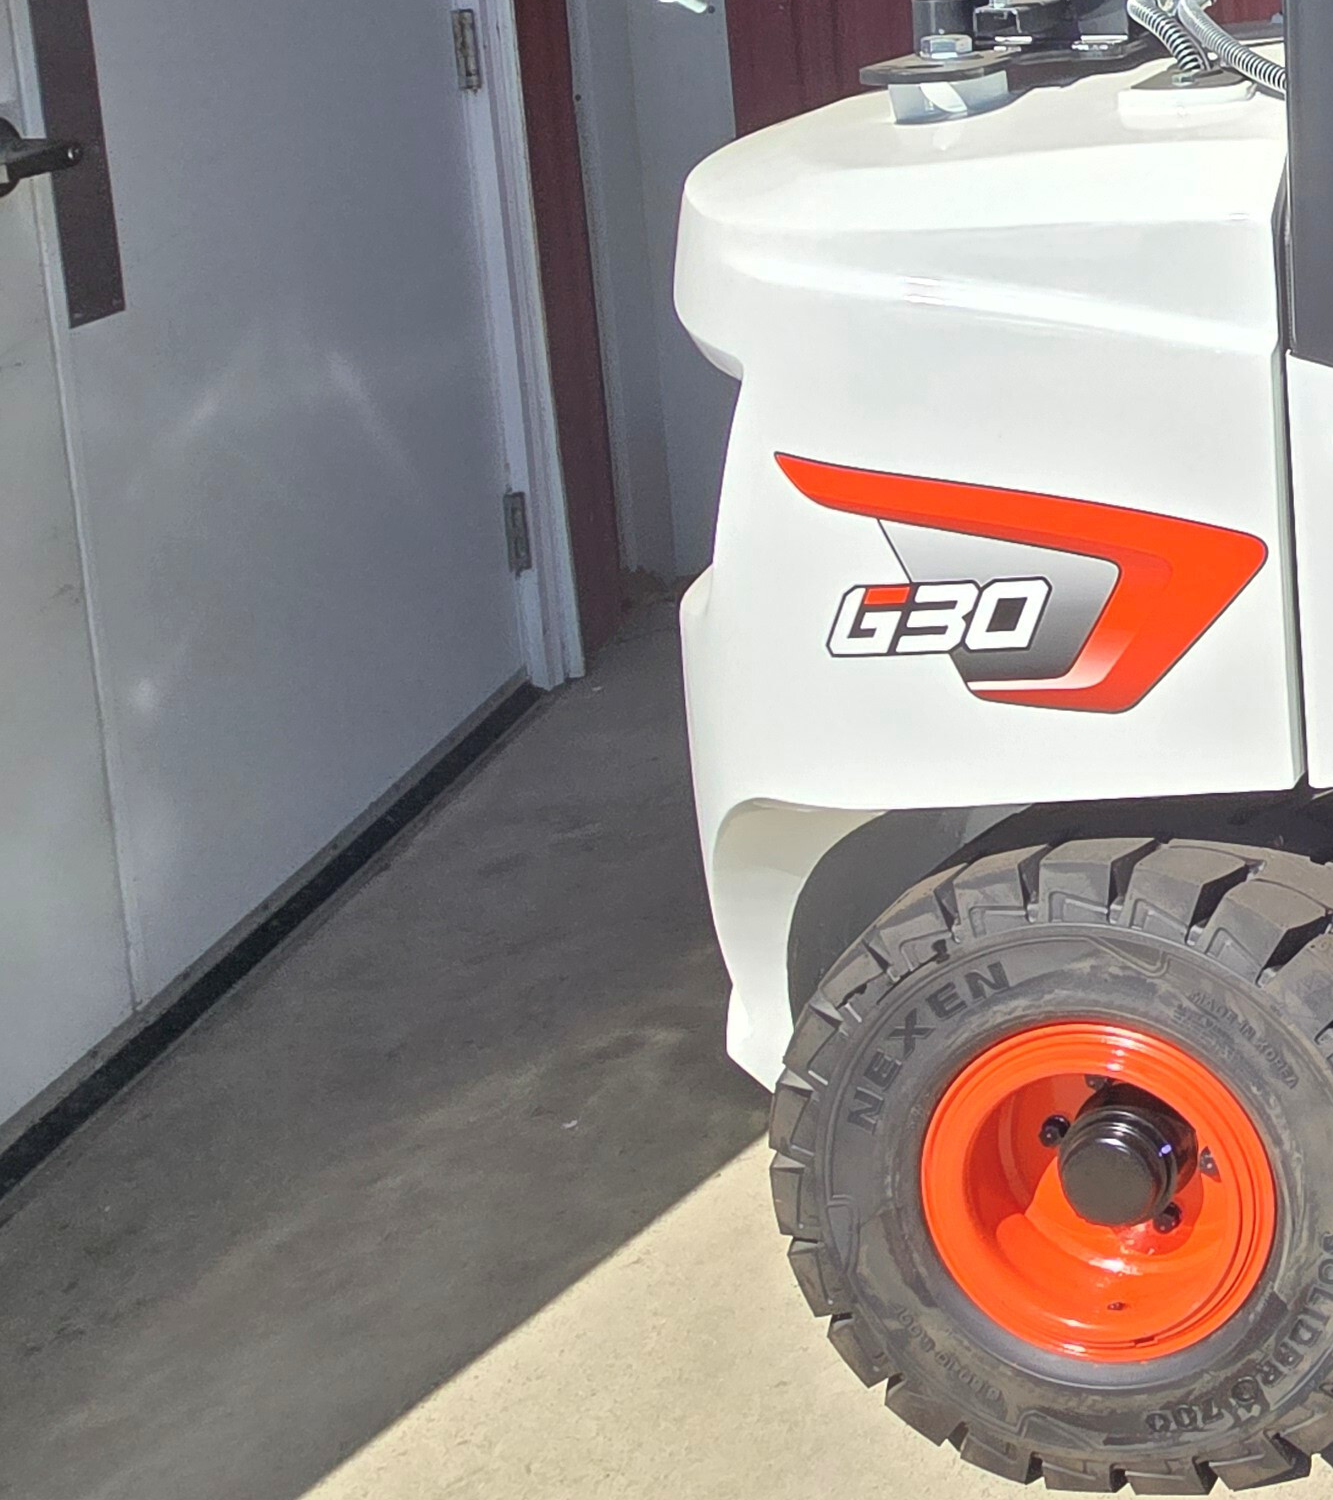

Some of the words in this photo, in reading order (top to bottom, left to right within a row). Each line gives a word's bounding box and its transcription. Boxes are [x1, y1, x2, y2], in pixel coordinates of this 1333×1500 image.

[826, 577, 1052, 657] G30
[847, 961, 1012, 1136] NEXEN
[1144, 1397, 1226, 1434] 700
